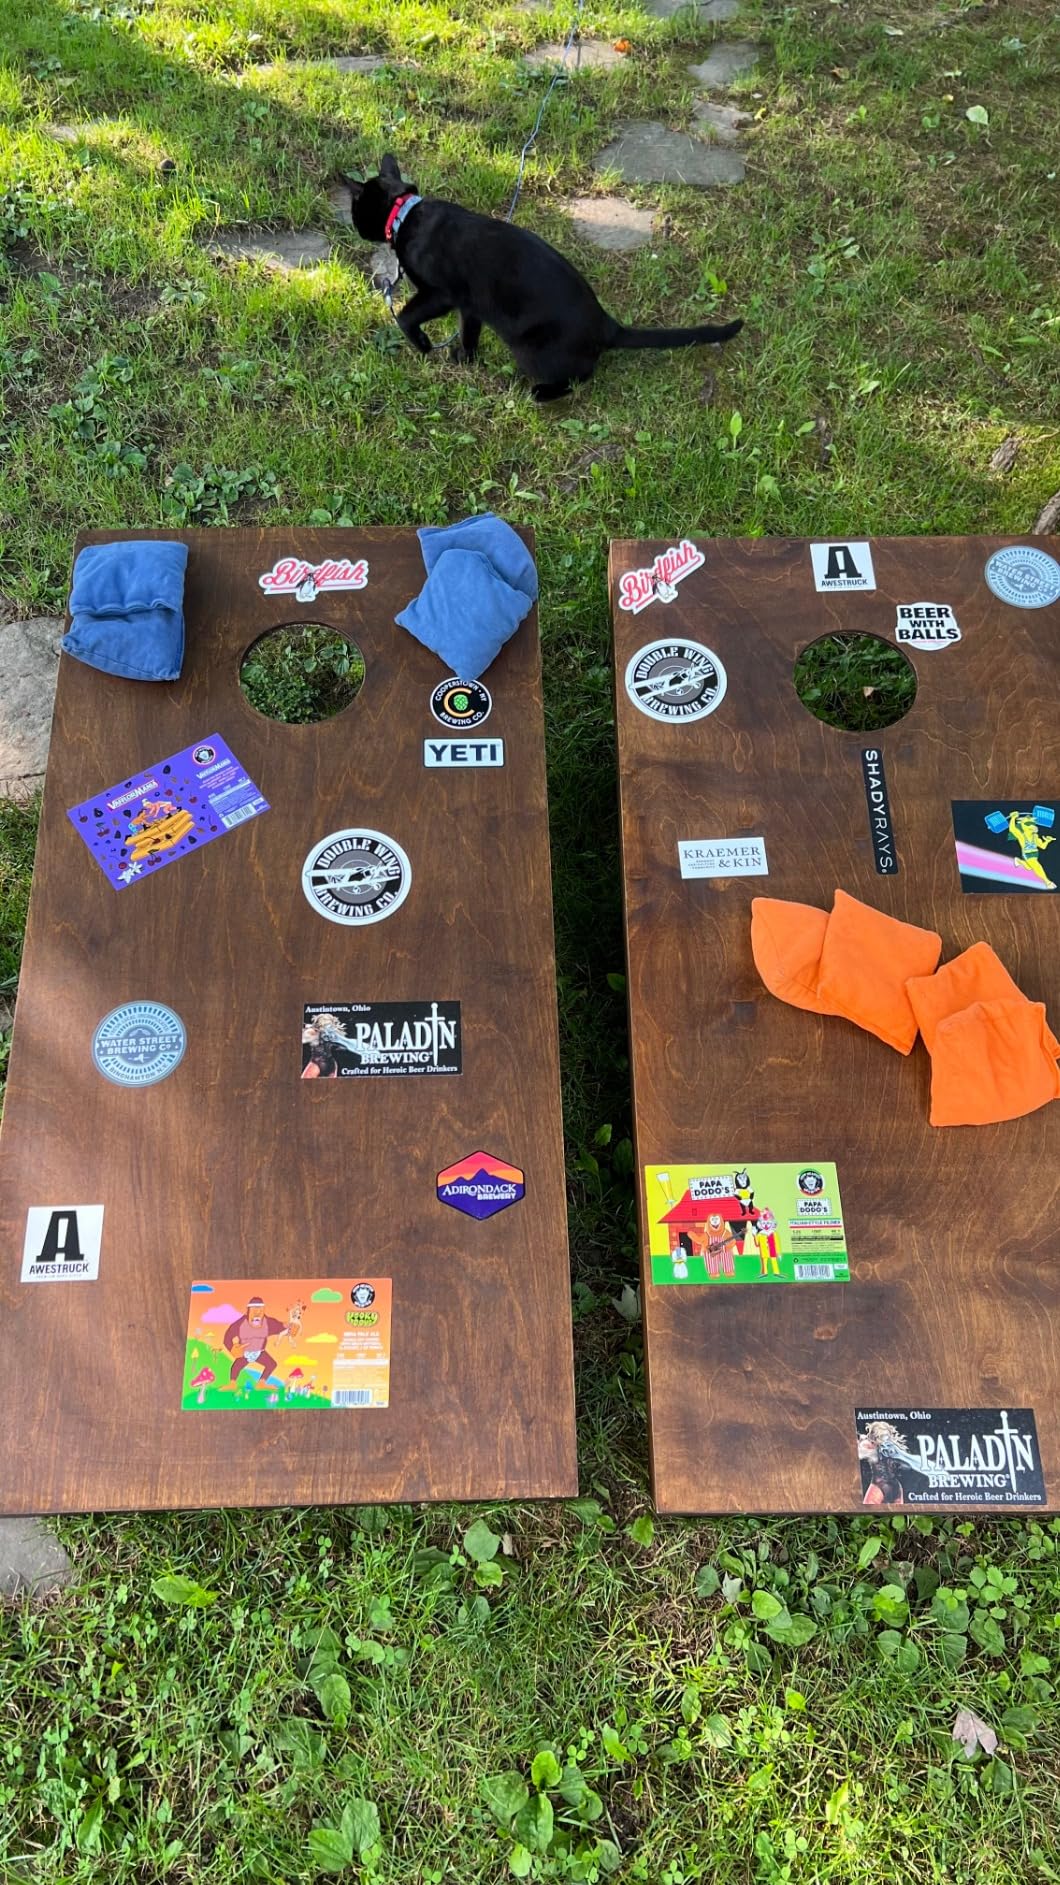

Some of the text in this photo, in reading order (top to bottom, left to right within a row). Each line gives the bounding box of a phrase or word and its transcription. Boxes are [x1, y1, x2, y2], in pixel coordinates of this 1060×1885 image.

[824, 546, 862, 579] A
[263, 560, 365, 588] Birdfish
[622, 543, 699, 606] Birdfish
[821, 579, 868, 587] AWESTRUCK
[900, 608, 950, 618] BEER
[909, 620, 944, 628] WITH
[898, 628, 958, 639] BALLS
[635, 646, 714, 679] DOUBLE WING
[440, 711, 472, 725] BREWING
[428, 744, 497, 762] YETI
[317, 838, 400, 876] DOUBLE WING
[683, 846, 761, 859] KRAEMER
[719, 859, 731, 868] &
[733, 857, 762, 868] KIN
[376, 891, 398, 909] CO.
[305, 1004, 371, 1013] Austintown, Ohio
[355, 1003, 457, 1050] PALADIN
[101, 1035, 177, 1048] WATER STREET
[107, 1044, 156, 1055] BREWING
[341, 1067, 369, 1075] Crafted
[383, 1066, 407, 1074] Heroic
[427, 1065, 457, 1073] Drinkers
[699, 1180, 722, 1188] PAPA
[442, 1184, 516, 1197] ADIRONDACK
[477, 1192, 516, 1200] BREWERY
[694, 1187, 730, 1196] DODO'S
[36, 1210, 84, 1262] A
[29, 1263, 89, 1275] AWESTRUCK
[857, 1411, 931, 1421] Austintown, Ohio
[917, 1411, 1034, 1471] PALADIN
[908, 1491, 1041, 1501] Crafted for Heroic Beer Drinkers
